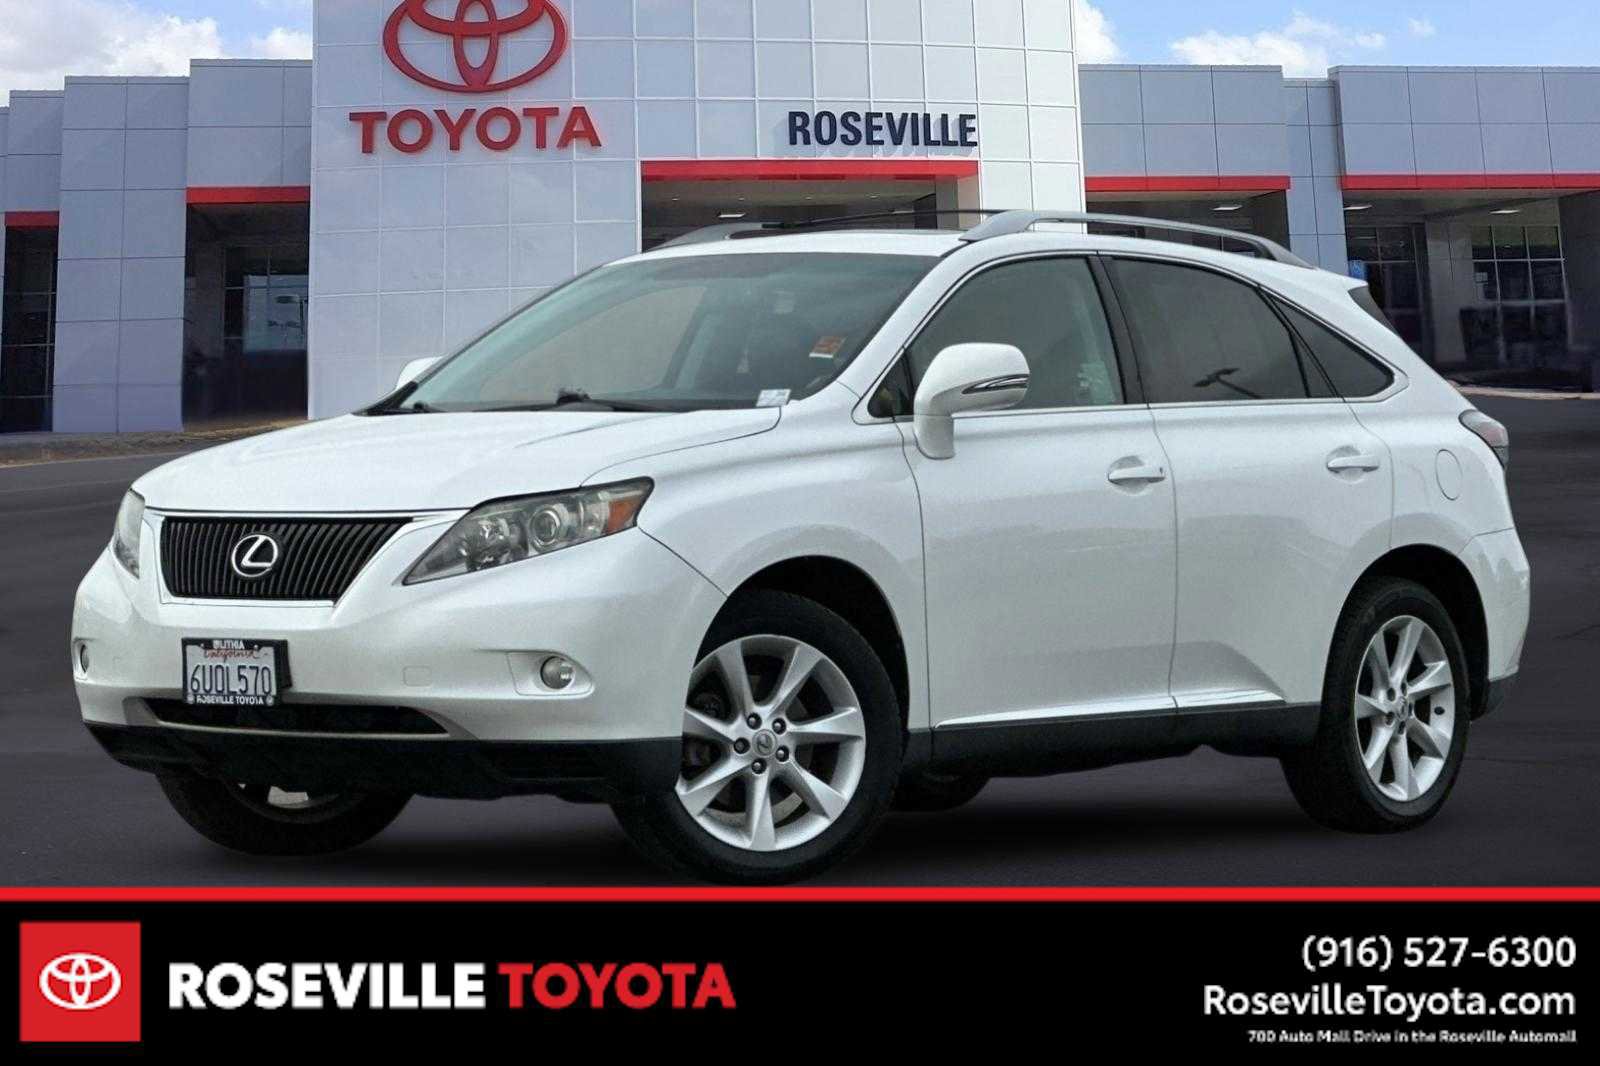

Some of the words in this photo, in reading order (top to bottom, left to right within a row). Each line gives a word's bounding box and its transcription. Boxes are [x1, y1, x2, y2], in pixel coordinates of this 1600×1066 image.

[349, 105, 603, 154] TOYOTA
[788, 110, 978, 148] ROSEVILLE
[196, 695, 234, 705] ROSEVILLE
[236, 696, 264, 705] TOYOTA
